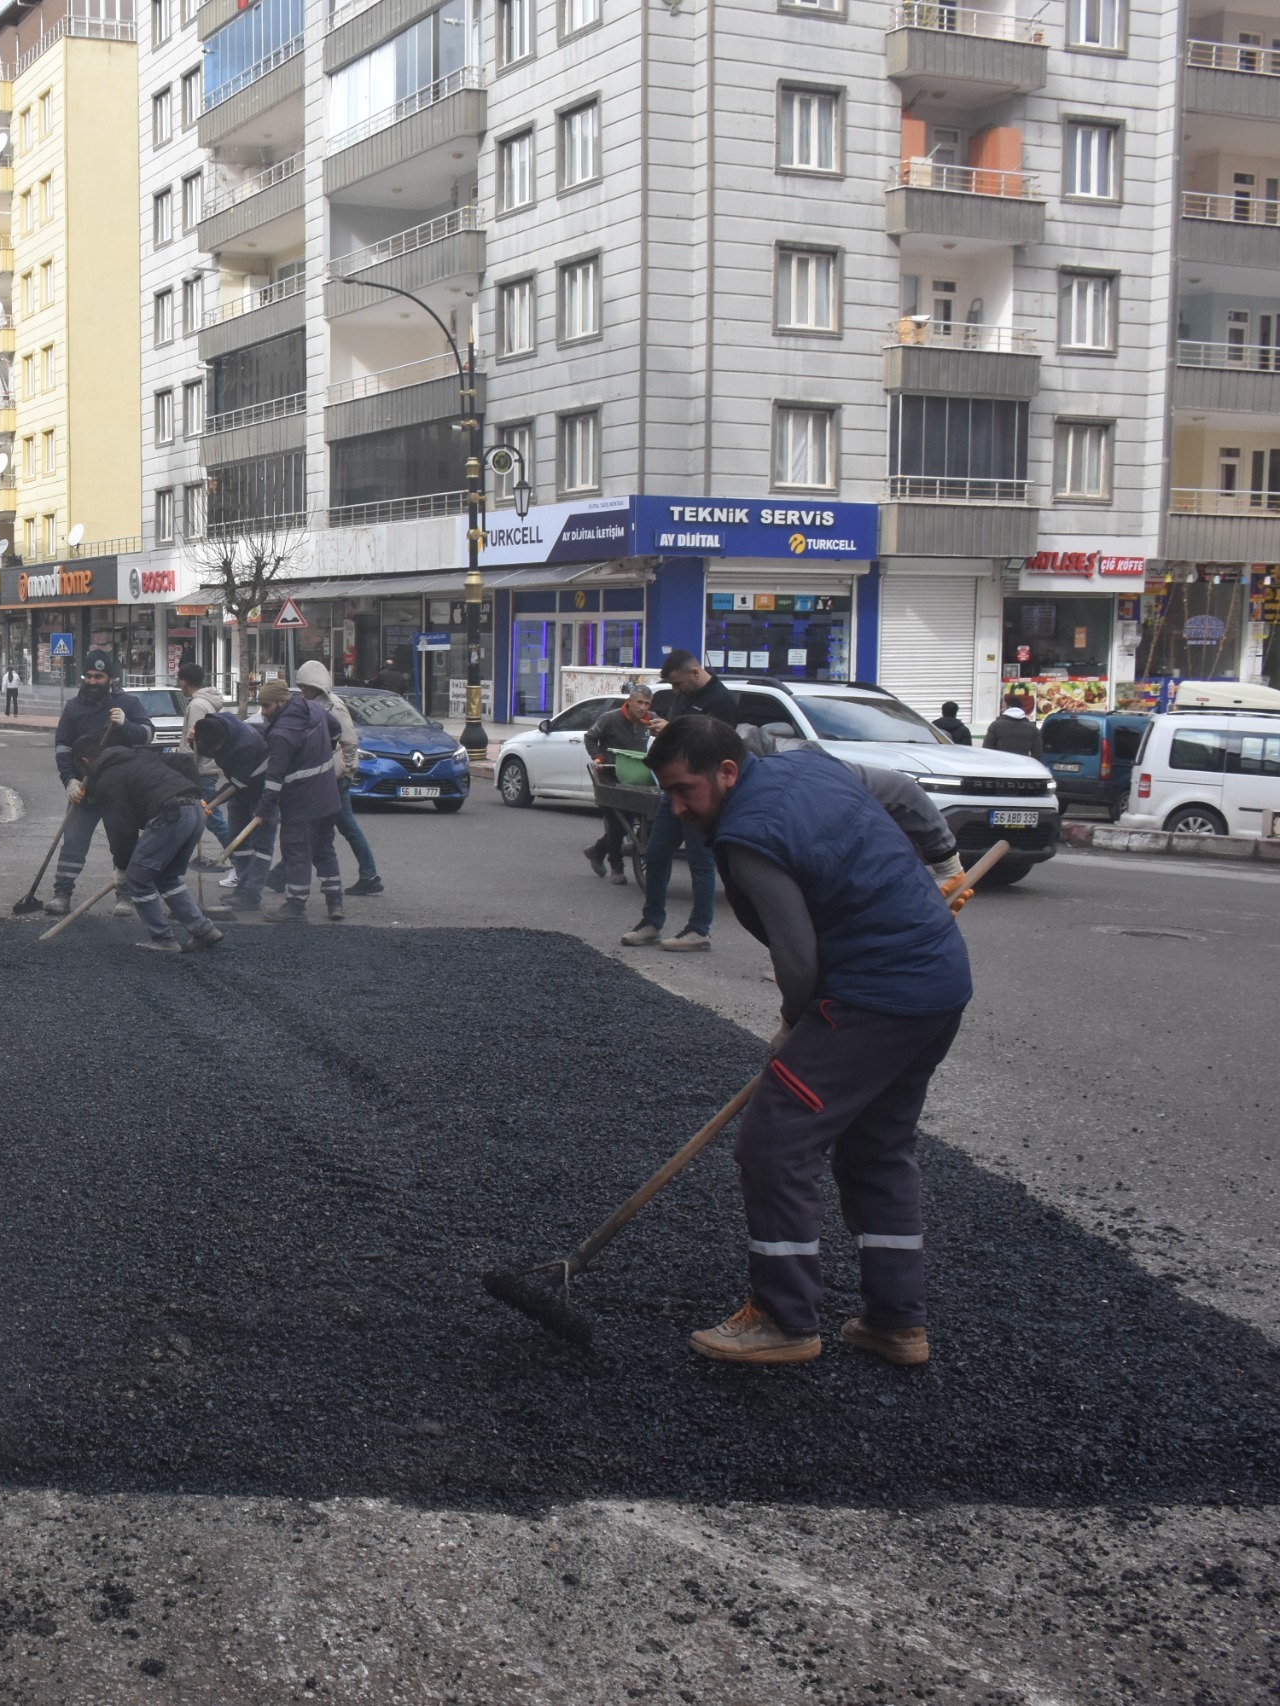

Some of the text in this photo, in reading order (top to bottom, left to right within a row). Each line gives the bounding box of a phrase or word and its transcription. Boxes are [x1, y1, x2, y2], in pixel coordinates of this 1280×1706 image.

[485, 525, 543, 548] TURKCELL
[562, 524, 625, 541] AY DİJİTAL İLETİŞİM
[659, 531, 721, 548] AY DİJİTAL
[806, 538, 857, 551] TURKCELL
[1101, 558, 1144, 573] ÇİĞ KÖFTE
[141, 570, 175, 593] BOSCH
[426, 788, 439, 796] 777
[974, 781, 1042, 789] RENAULT
[994, 813, 1005, 823] 56
[1023, 813, 1037, 823] 335
